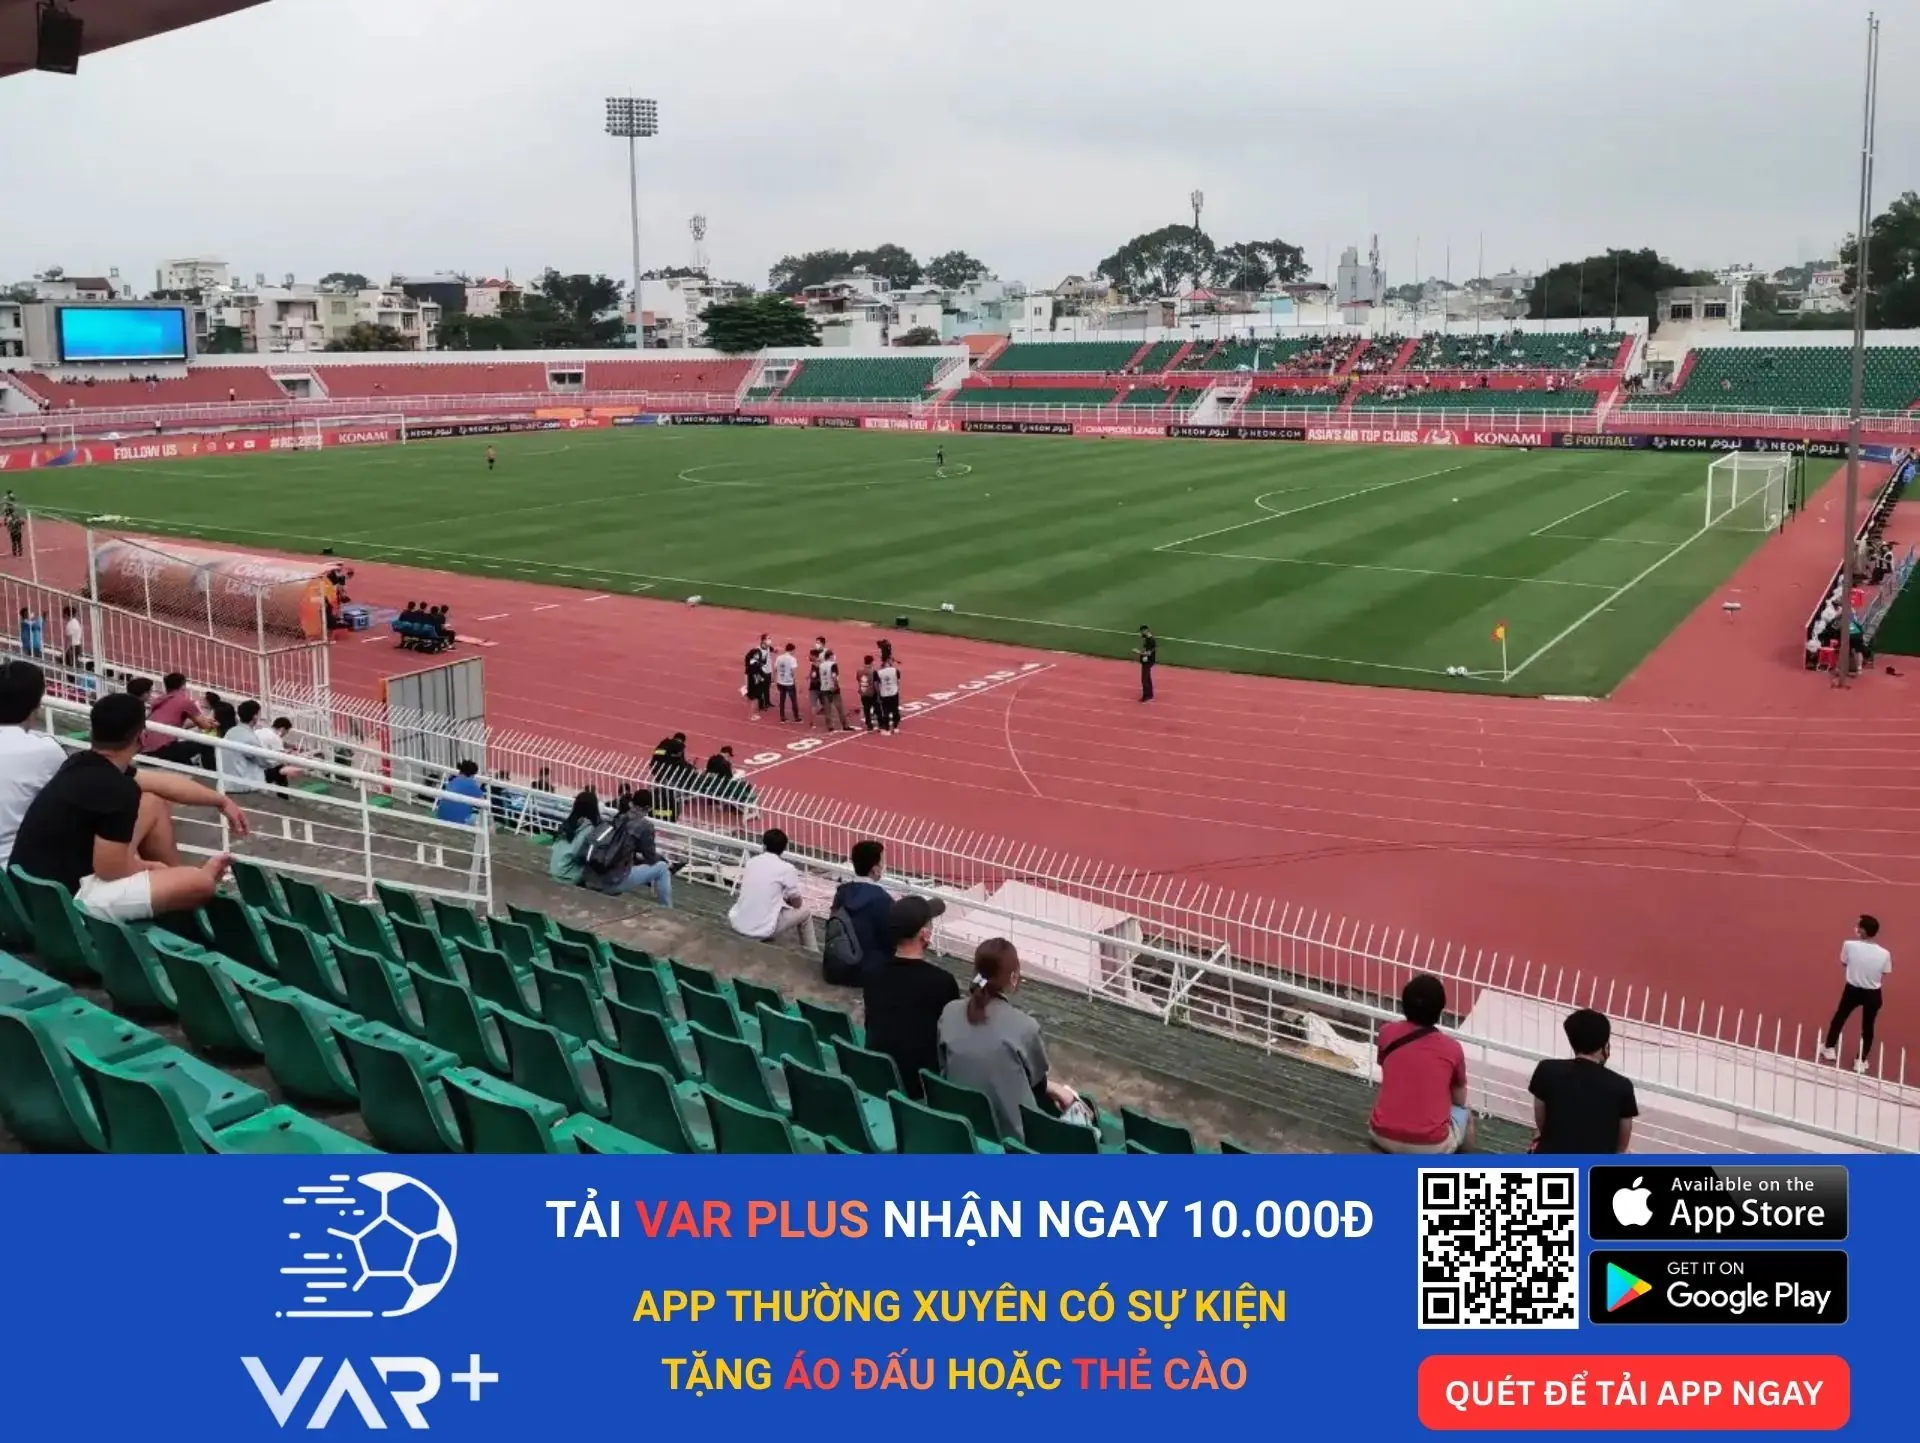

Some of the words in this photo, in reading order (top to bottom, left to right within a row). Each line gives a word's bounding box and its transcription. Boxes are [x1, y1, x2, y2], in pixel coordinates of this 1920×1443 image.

[773, 416, 809, 425] KONAMI
[1133, 427, 1165, 435] LEAGUE
[1182, 428, 1206, 436] NEOM
[1249, 429, 1301, 438] NEOM.COM
[338, 431, 389, 444] KONAMI
[1361, 430, 1381, 442] TOP
[1382, 430, 1419, 443] CLUBS
[1473, 431, 1542, 445] KONAMI
[1670, 439, 1706, 448] NEOM
[1770, 441, 1805, 451] NEOM
[114, 445, 160, 460] FOLLOW
[162, 443, 178, 457] US
[786, 737, 823, 751] 8
